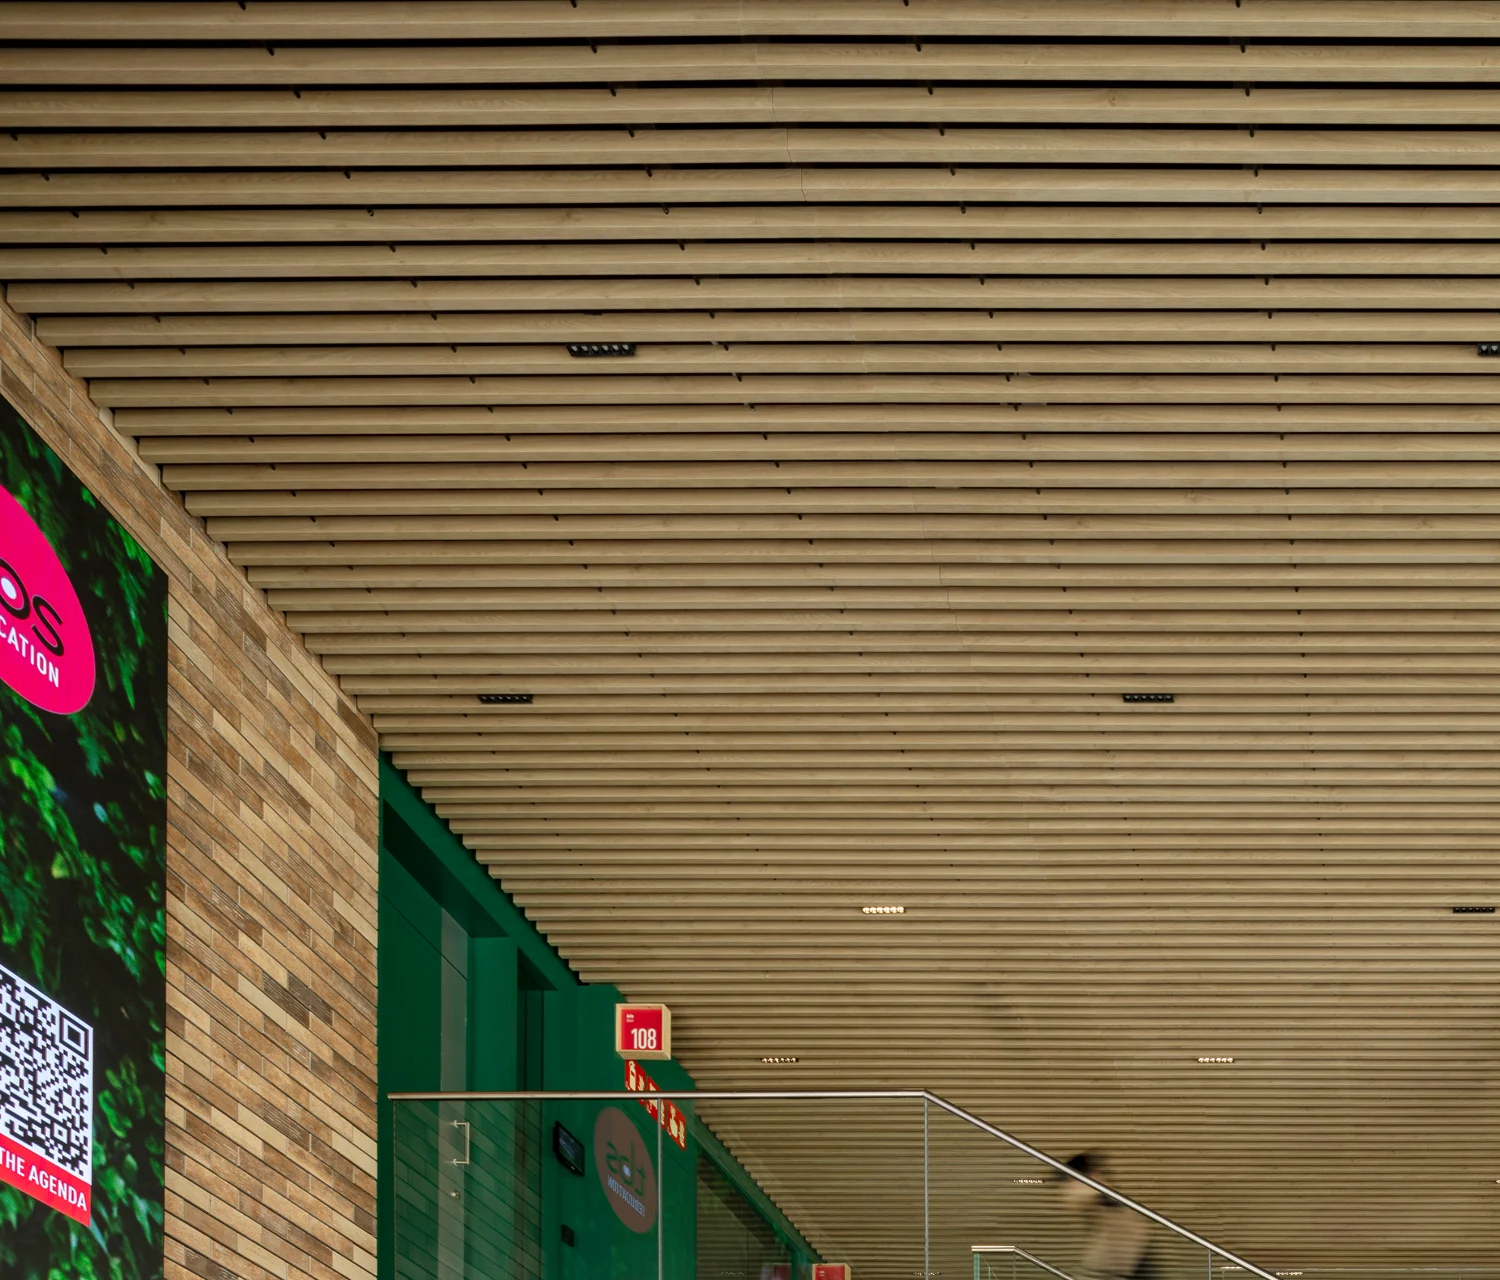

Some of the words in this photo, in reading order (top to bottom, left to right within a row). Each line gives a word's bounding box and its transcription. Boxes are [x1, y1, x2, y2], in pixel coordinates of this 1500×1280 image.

[631, 1028, 657, 1049] 108
[0, 1146, 25, 1178] THE
[28, 1164, 87, 1212] AGENDA
